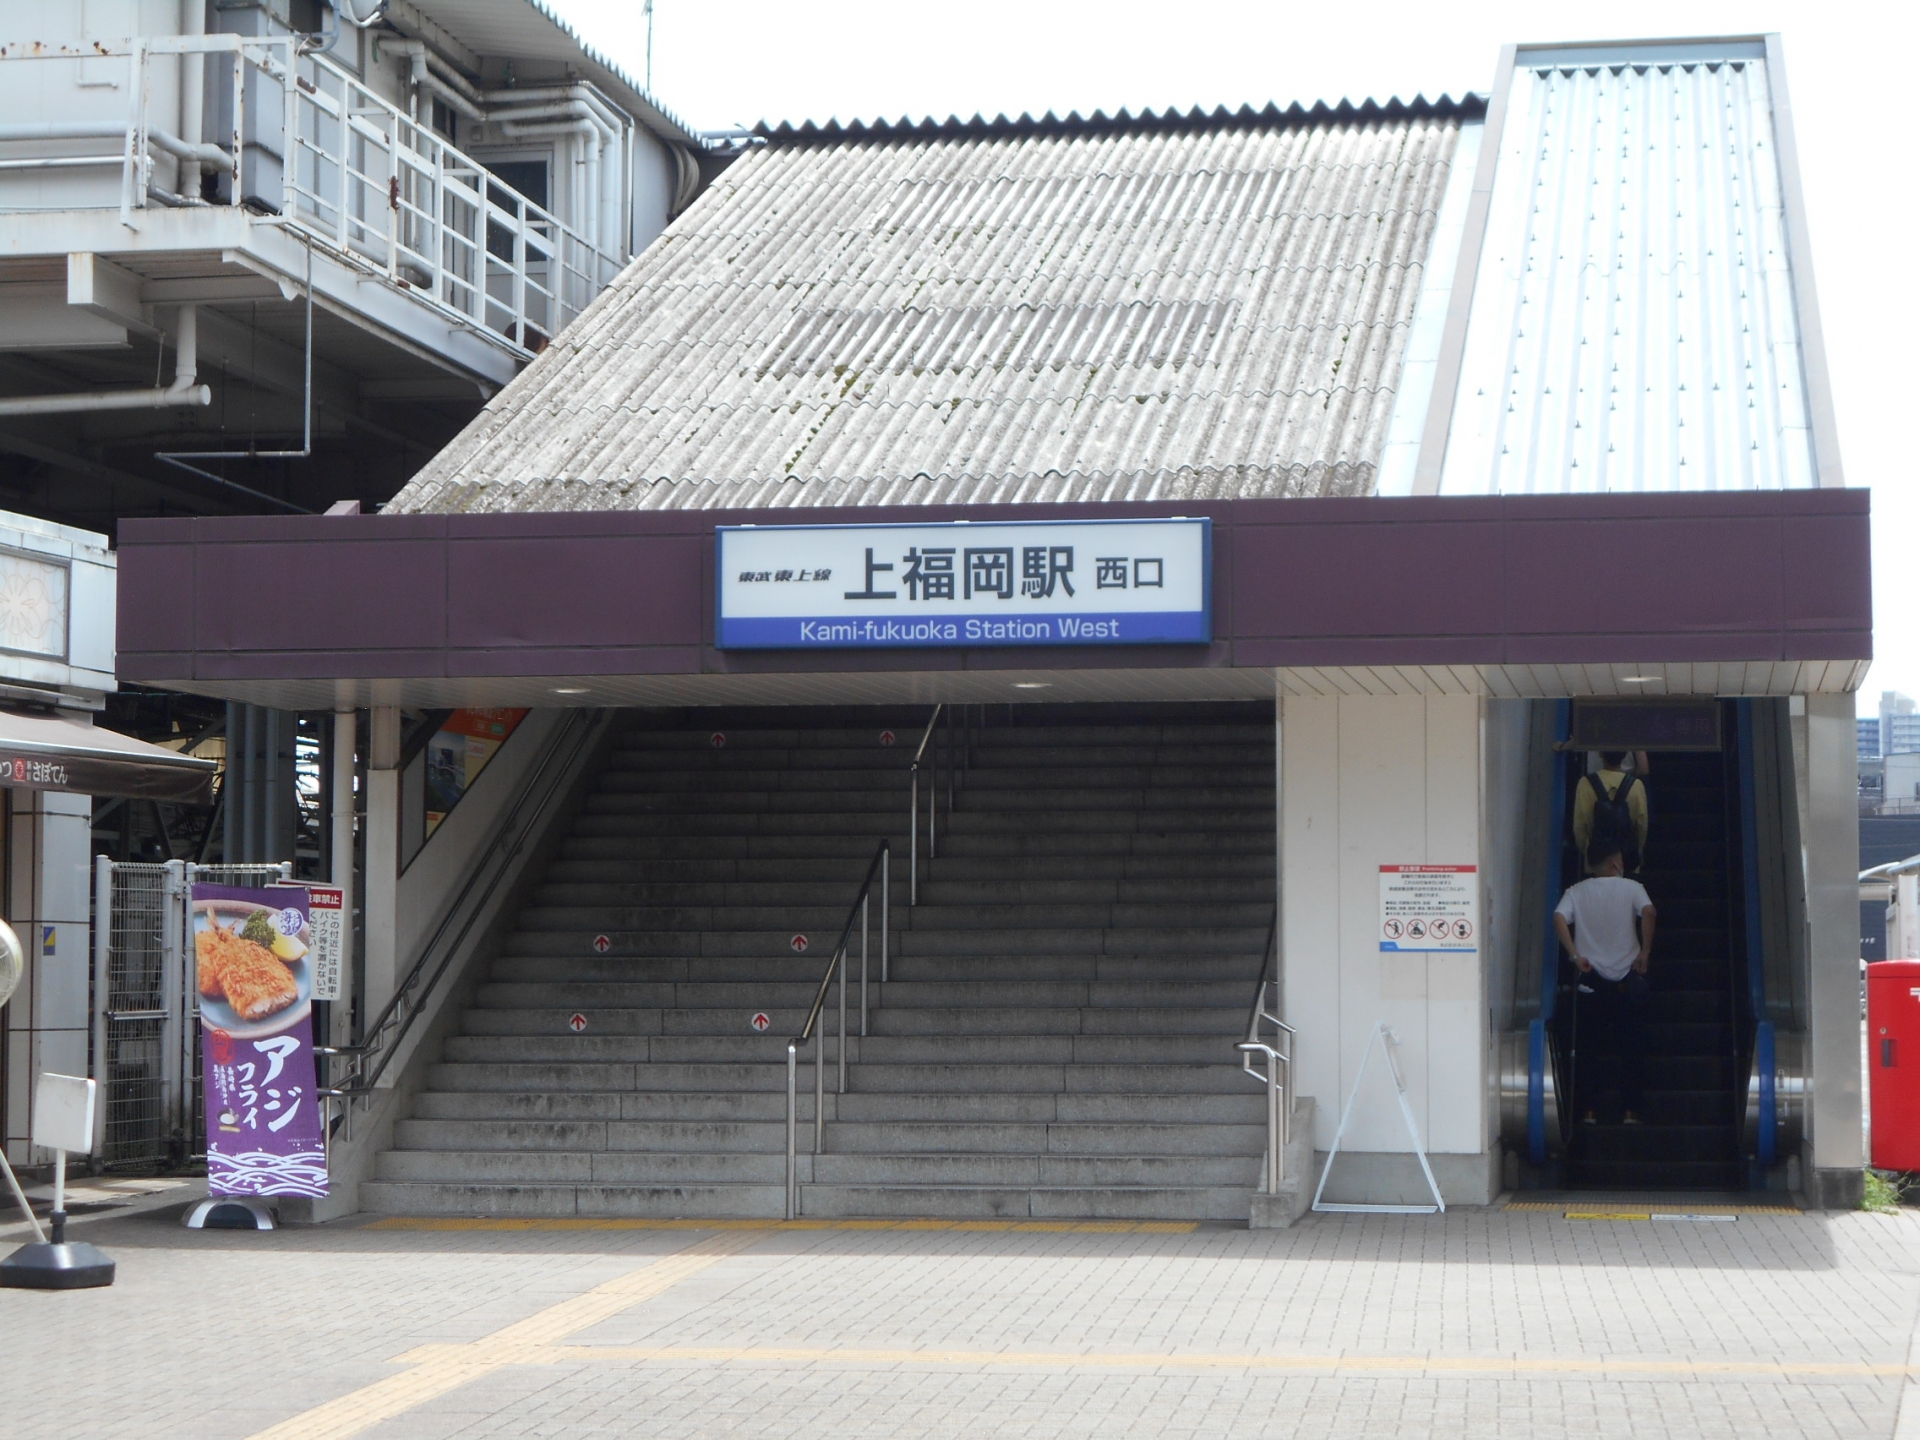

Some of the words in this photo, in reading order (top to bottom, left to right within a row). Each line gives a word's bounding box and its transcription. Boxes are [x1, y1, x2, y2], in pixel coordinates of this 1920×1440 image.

[738, 568, 832, 583] 東武東上線
[844, 546, 1076, 601] 上福岡駅
[1096, 557, 1163, 589] 西口
[800, 620, 957, 641] Kami-fukuoka
[965, 618, 1050, 639] Station
[1058, 618, 1120, 638] West
[32, 761, 68, 784] さぼてん
[237, 1062, 258, 1129] フライ
[253, 1035, 302, 1132] アジ
